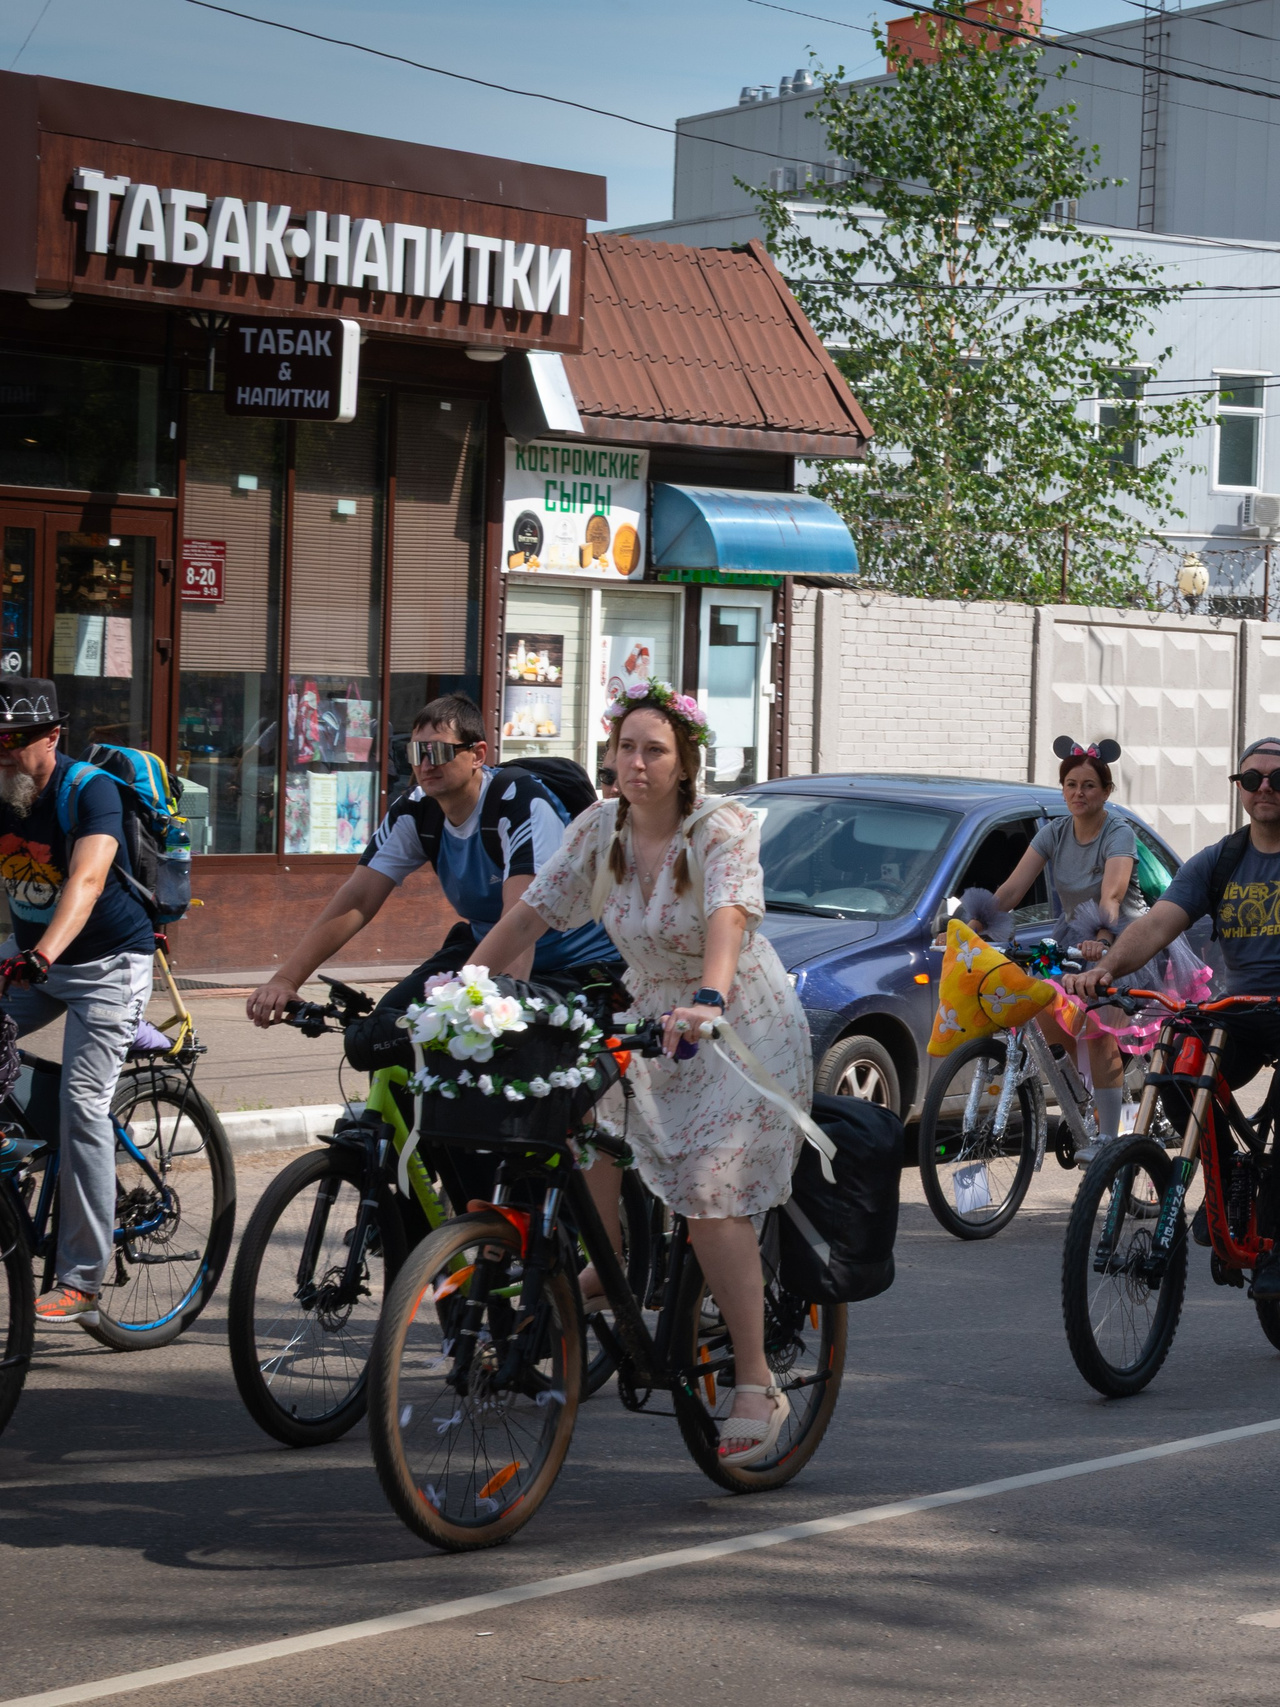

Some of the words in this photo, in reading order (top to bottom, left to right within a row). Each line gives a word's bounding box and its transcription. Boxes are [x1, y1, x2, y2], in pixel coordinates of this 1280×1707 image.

[239, 327, 333, 357] ТАБАК
[278, 362, 292, 381] &
[236, 386, 330, 409] НАПИТКИ
[515, 443, 640, 480] КОСТРОМСКИЕ
[545, 479, 612, 516] СЫРЫ
[186, 567, 216, 586] 8-20
[1222, 926, 1258, 939] WHILE
